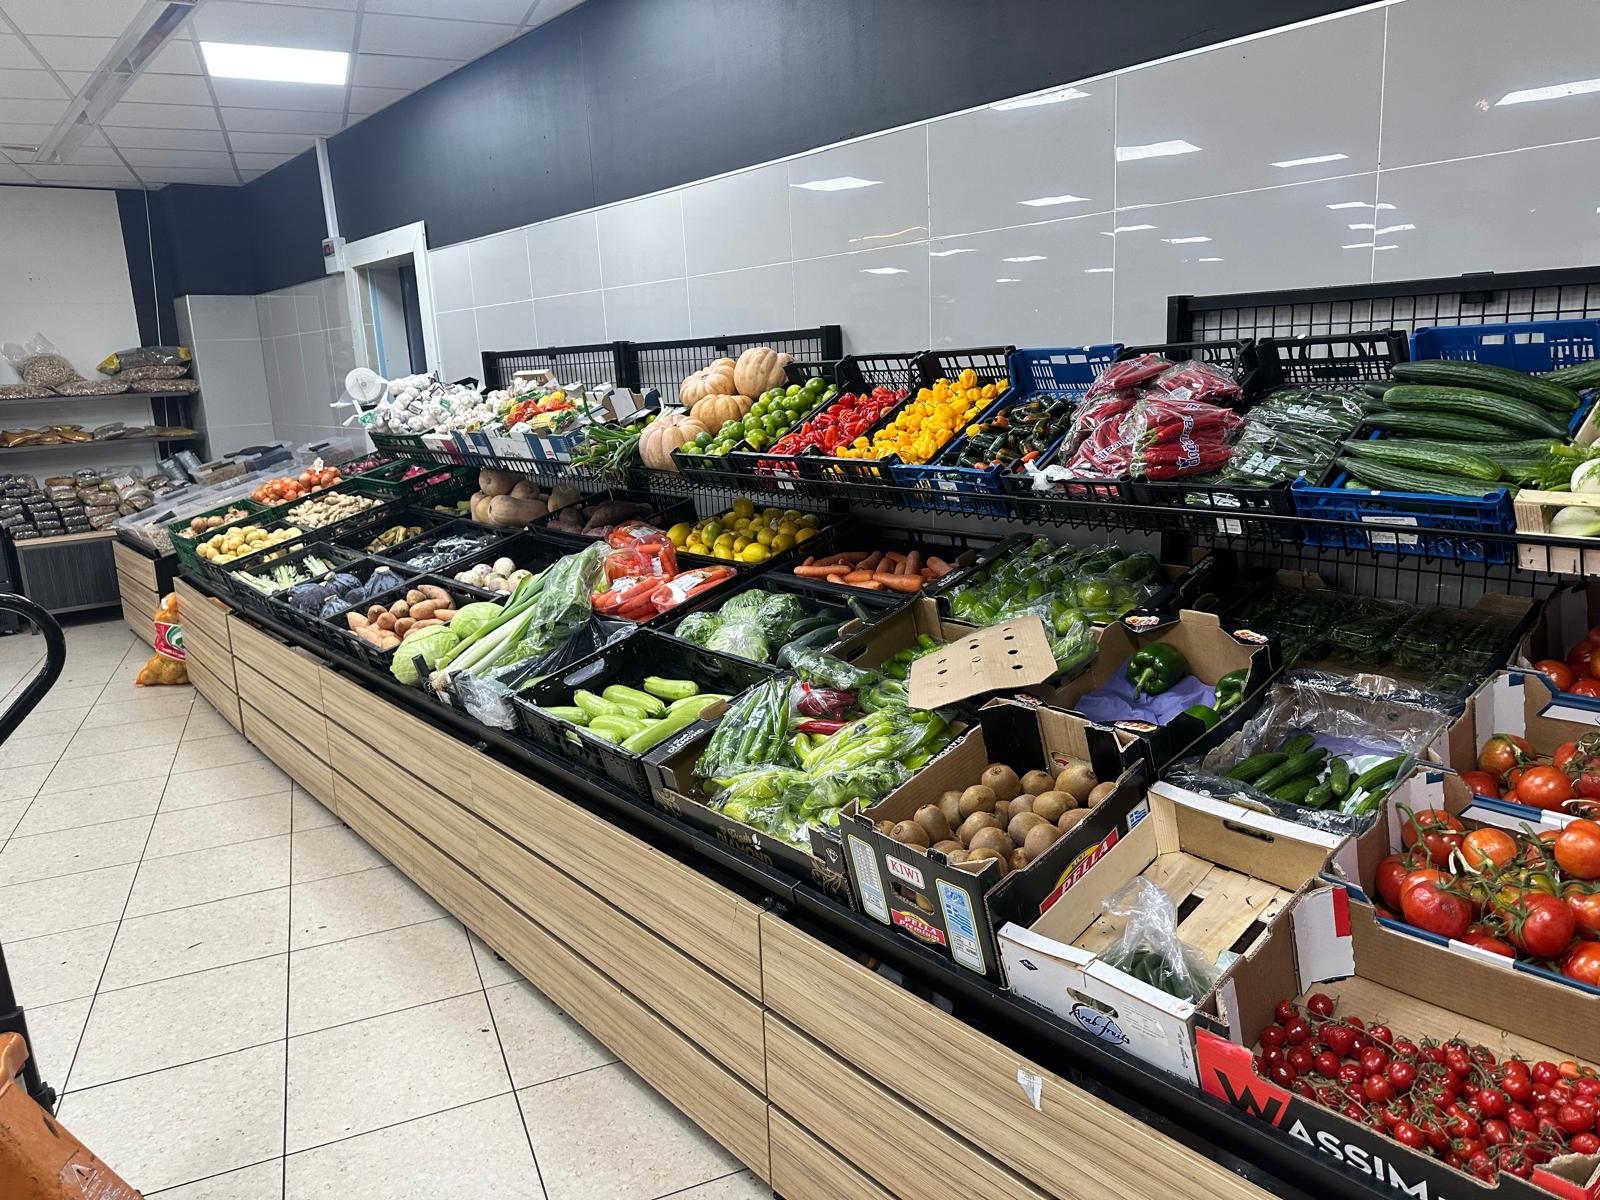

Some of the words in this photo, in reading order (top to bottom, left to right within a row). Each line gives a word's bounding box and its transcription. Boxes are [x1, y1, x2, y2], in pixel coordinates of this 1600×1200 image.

[667, 728, 705, 754] DIAMOND
[890, 860, 920, 884] KIWI
[1062, 841, 1108, 894] PELLA
[899, 919, 939, 941] Premium
[904, 916, 937, 935] PELLA
[1069, 1008, 1100, 1026] Arab
[1097, 1016, 1130, 1044] fruits
